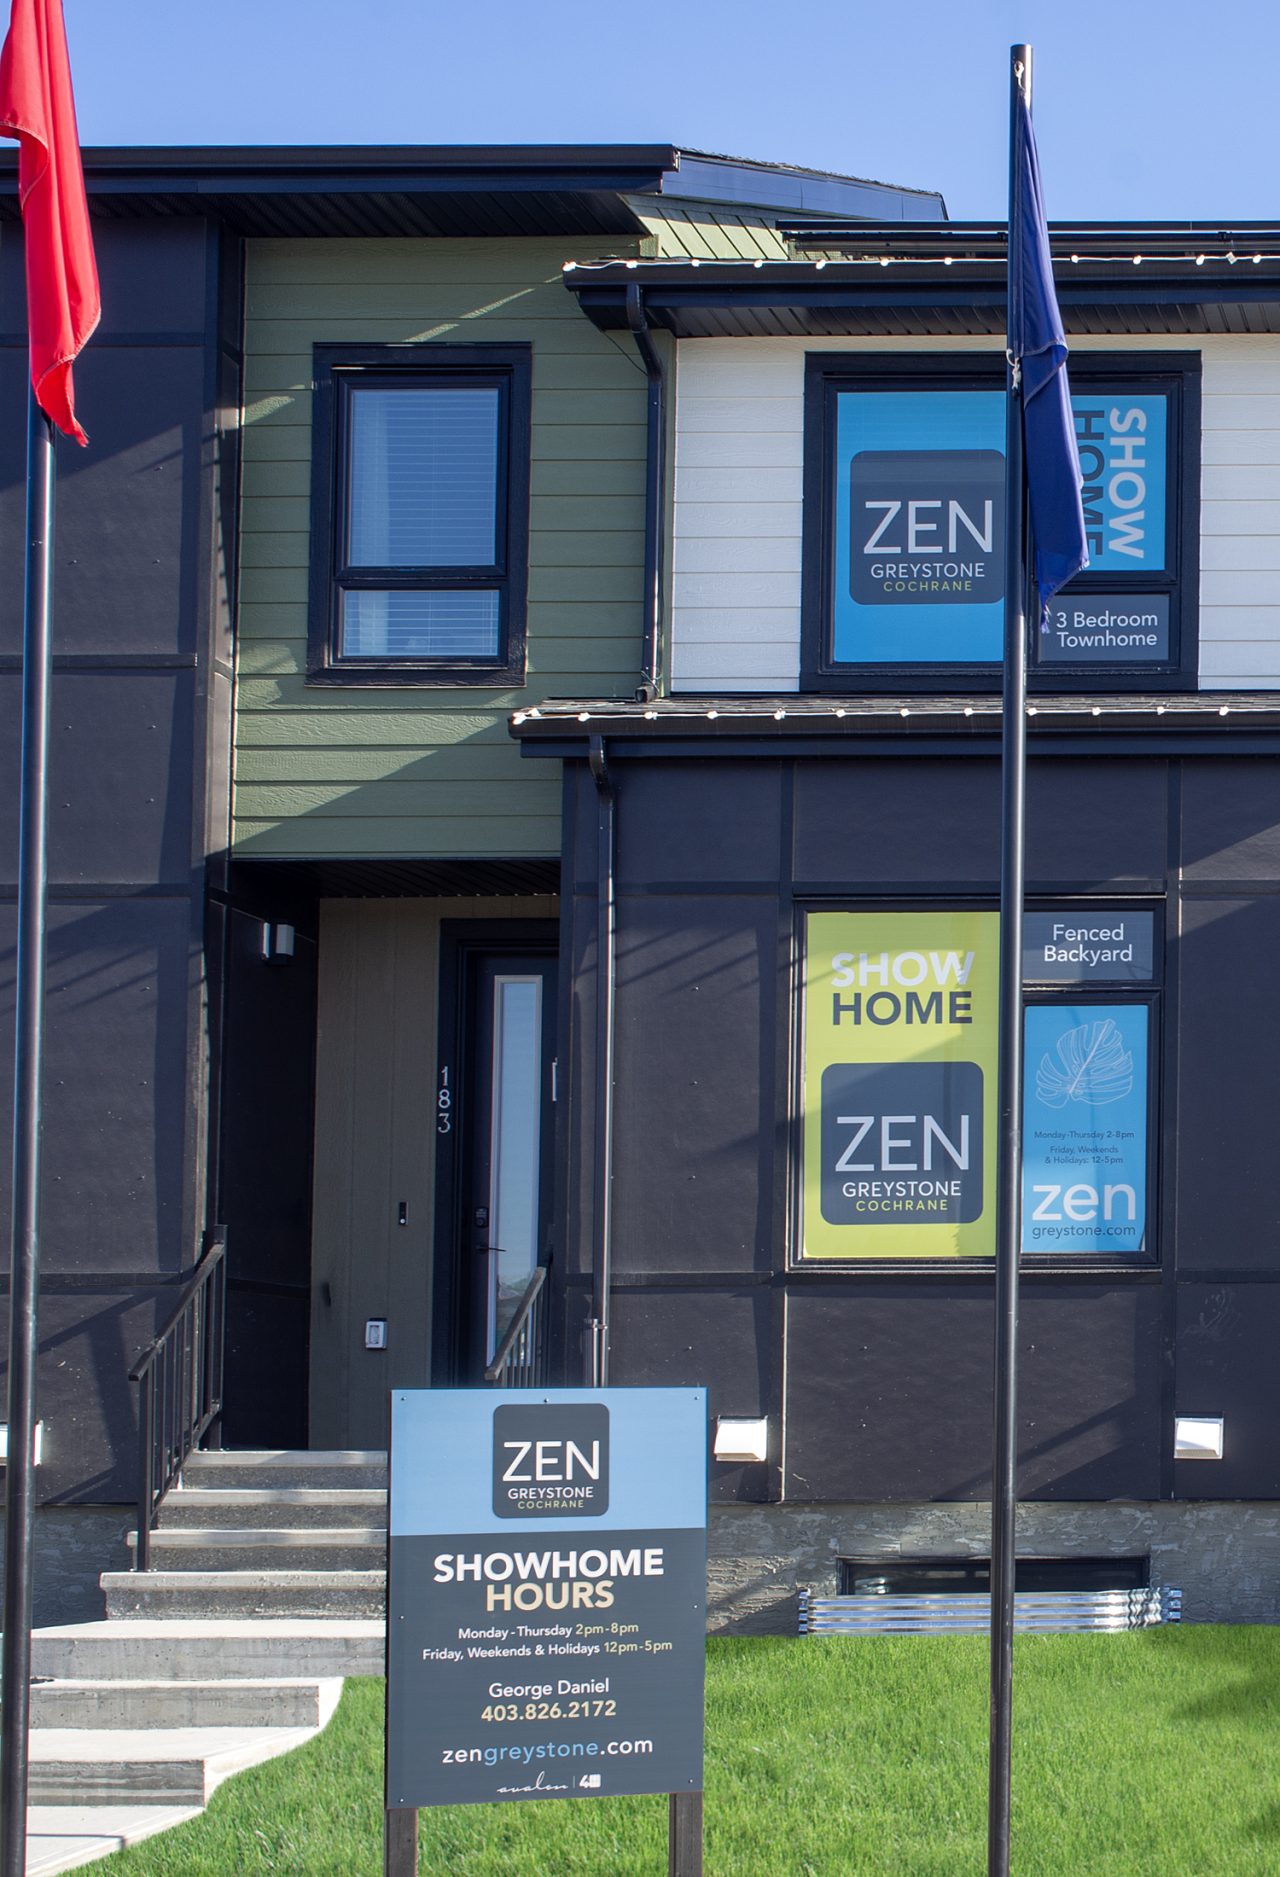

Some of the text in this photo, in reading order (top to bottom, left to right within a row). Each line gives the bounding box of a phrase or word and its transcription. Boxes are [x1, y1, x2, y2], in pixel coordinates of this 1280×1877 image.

[1108, 407, 1147, 559] SHOW
[863, 499, 993, 554] ZEN
[870, 562, 985, 579] GREYSTONE
[883, 580, 972, 593] COCHRANE
[1056, 611, 1158, 628] 3 Bedroom
[1056, 630, 1158, 648] Townhome
[1052, 923, 1125, 942] Fenced
[1043, 944, 1133, 967] Backyard
[830, 950, 976, 988] SHOW
[832, 990, 974, 1026] HOME
[437, 1065, 451, 1133] 183
[835, 1114, 970, 1172] ZEN
[1078, 1145, 1119, 1154] Weekends
[842, 1180, 962, 1198] GREYSTONE
[855, 1199, 949, 1212] COCHRANE
[1031, 1183, 1136, 1221] zen
[1032, 1225, 1136, 1240] greystone.com
[502, 1440, 600, 1482] ZEN
[507, 1486, 594, 1500] GREYSTONE
[517, 1500, 584, 1510] COCHRANE
[433, 1547, 665, 1583] SHOWHOME
[486, 1579, 615, 1612] HOURS
[422, 1648, 464, 1662] Friday,
[467, 1645, 532, 1659] Weekends
[534, 1644, 545, 1656] &
[548, 1642, 600, 1657] Holidays
[488, 1678, 610, 1700] George Daniel
[481, 1699, 617, 1722] 403.826.2172
[441, 1737, 654, 1766] zengreystone.com
